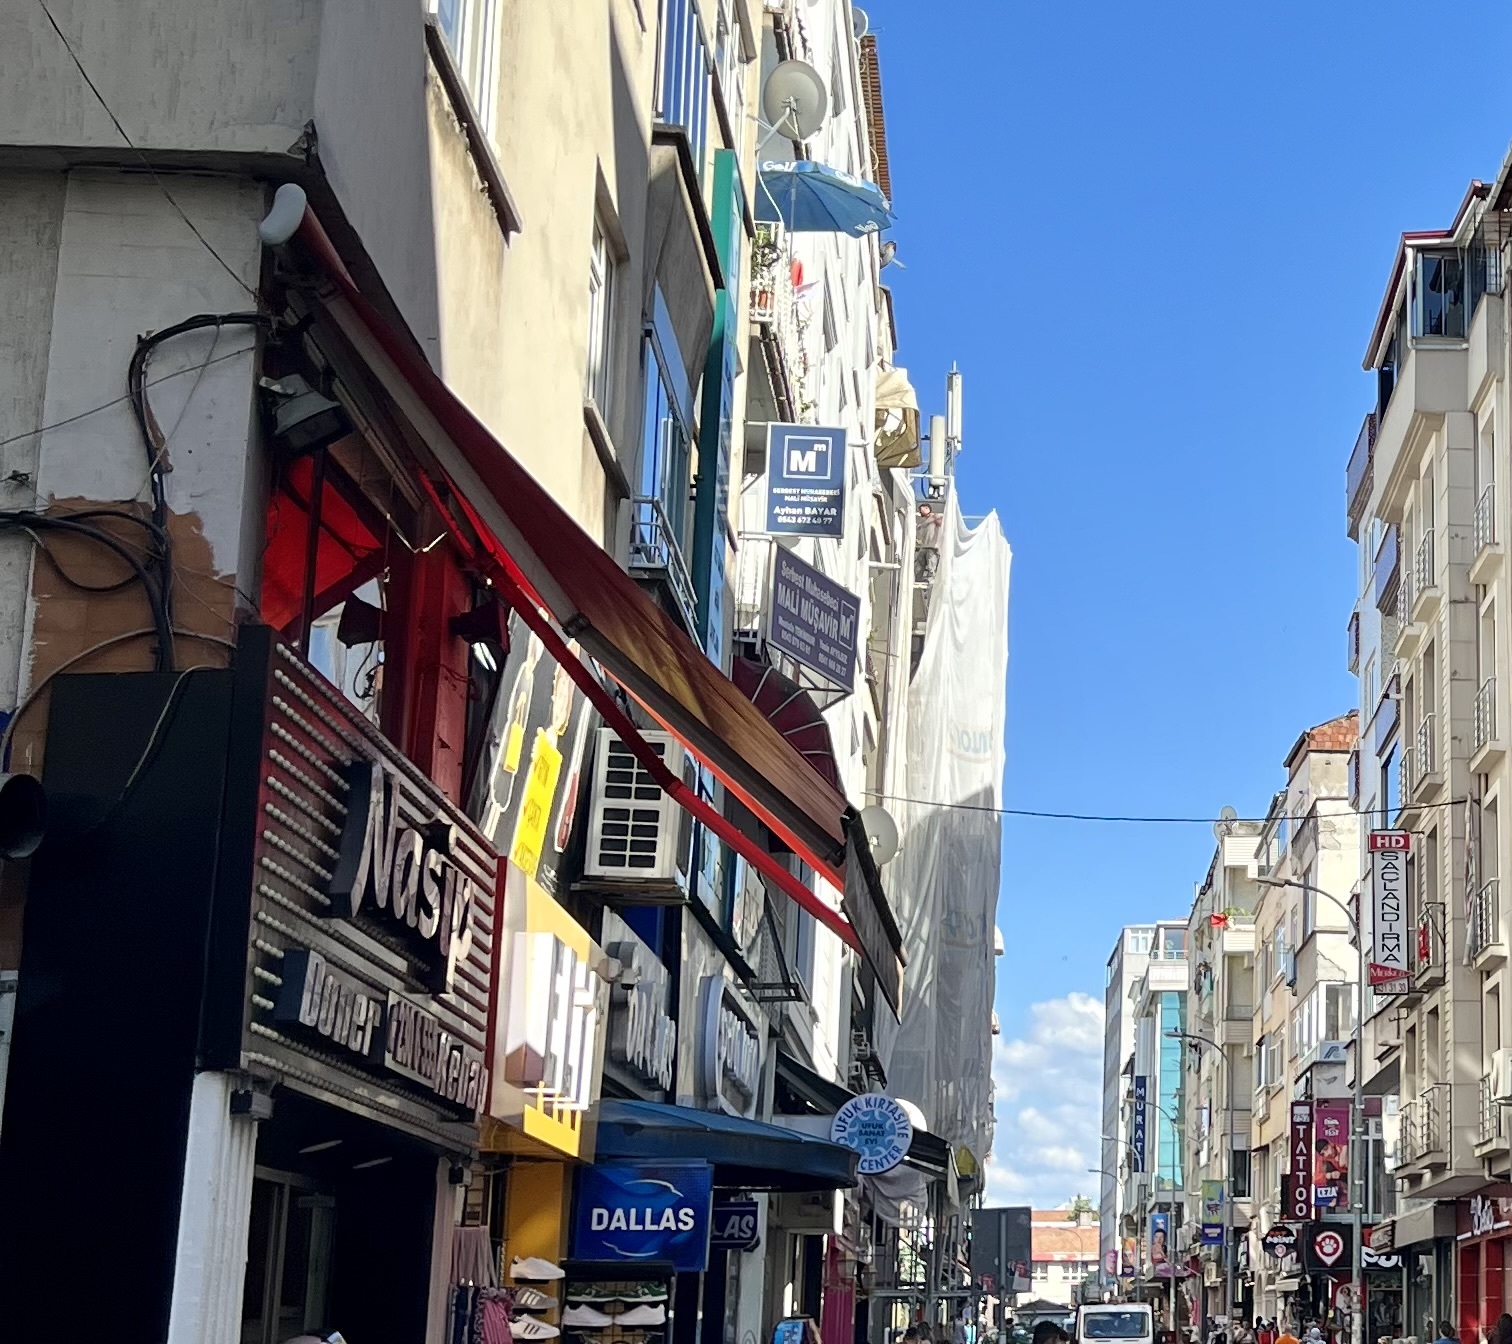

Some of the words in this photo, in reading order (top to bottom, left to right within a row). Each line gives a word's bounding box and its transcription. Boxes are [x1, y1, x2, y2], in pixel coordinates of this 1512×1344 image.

[774, 505, 802, 516] Ayhan
[804, 506, 837, 516] BAYAR
[777, 582, 800, 615] MALİ
[800, 597, 839, 641] MÜŞAVİR
[1376, 836, 1405, 848] HD
[1381, 851, 1400, 963] SAÇLANDIRMA
[834, 1100, 862, 1133] UFUK
[860, 1145, 904, 1171] CENTER
[1135, 1087, 1146, 1154] MURAT
[1295, 1125, 1307, 1217] TATTOO
[590, 1207, 695, 1231] DALLAS
